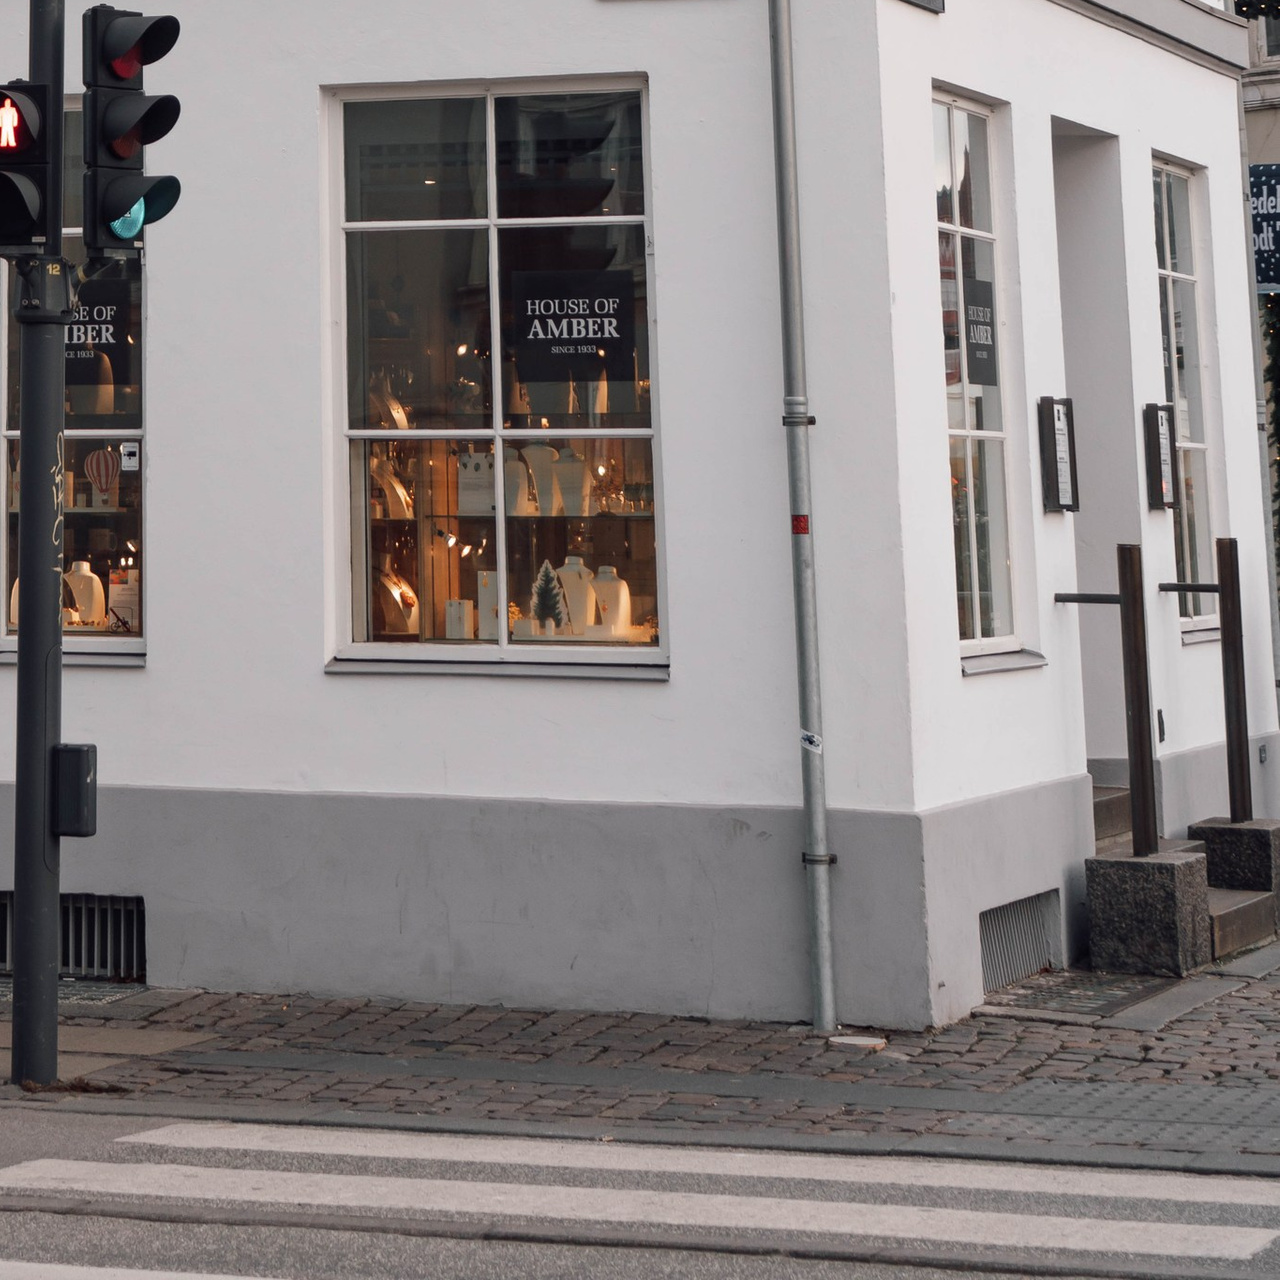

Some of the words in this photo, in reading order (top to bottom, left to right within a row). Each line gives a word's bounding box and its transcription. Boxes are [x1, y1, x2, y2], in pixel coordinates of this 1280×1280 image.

[46, 263, 61, 275] 12
[93, 306, 117, 321] OF
[526, 299, 590, 315] HOUSE
[594, 298, 620, 314] OF
[64, 324, 116, 344] BER
[527, 317, 620, 339] AMBER
[970, 324, 993, 345] AMBER
[77, 350, 94, 358] 1933
[551, 345, 576, 354] SINCE
[577, 345, 597, 354] 1933
